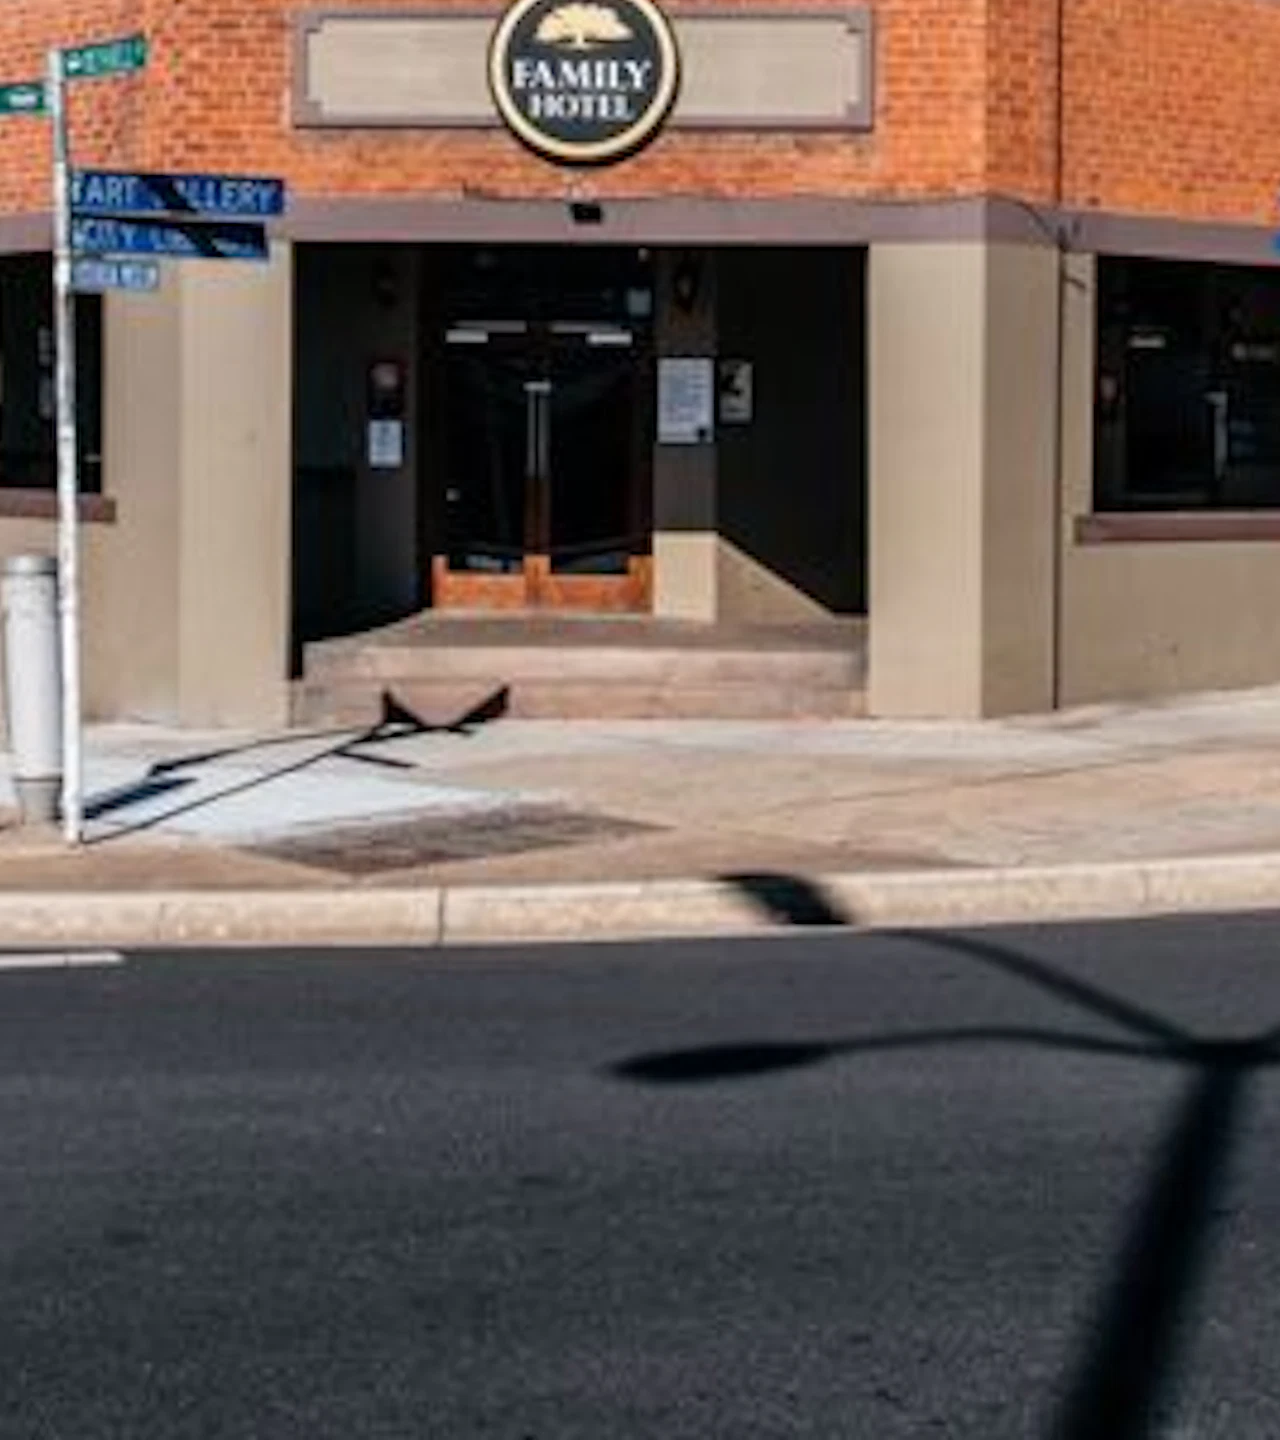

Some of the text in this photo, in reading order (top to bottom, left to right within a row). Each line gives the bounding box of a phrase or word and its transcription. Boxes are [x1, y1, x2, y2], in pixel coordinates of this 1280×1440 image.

[512, 59, 652, 90] FAMILY
[529, 93, 635, 119] HOTEL
[85, 174, 279, 213] ART LLERY
